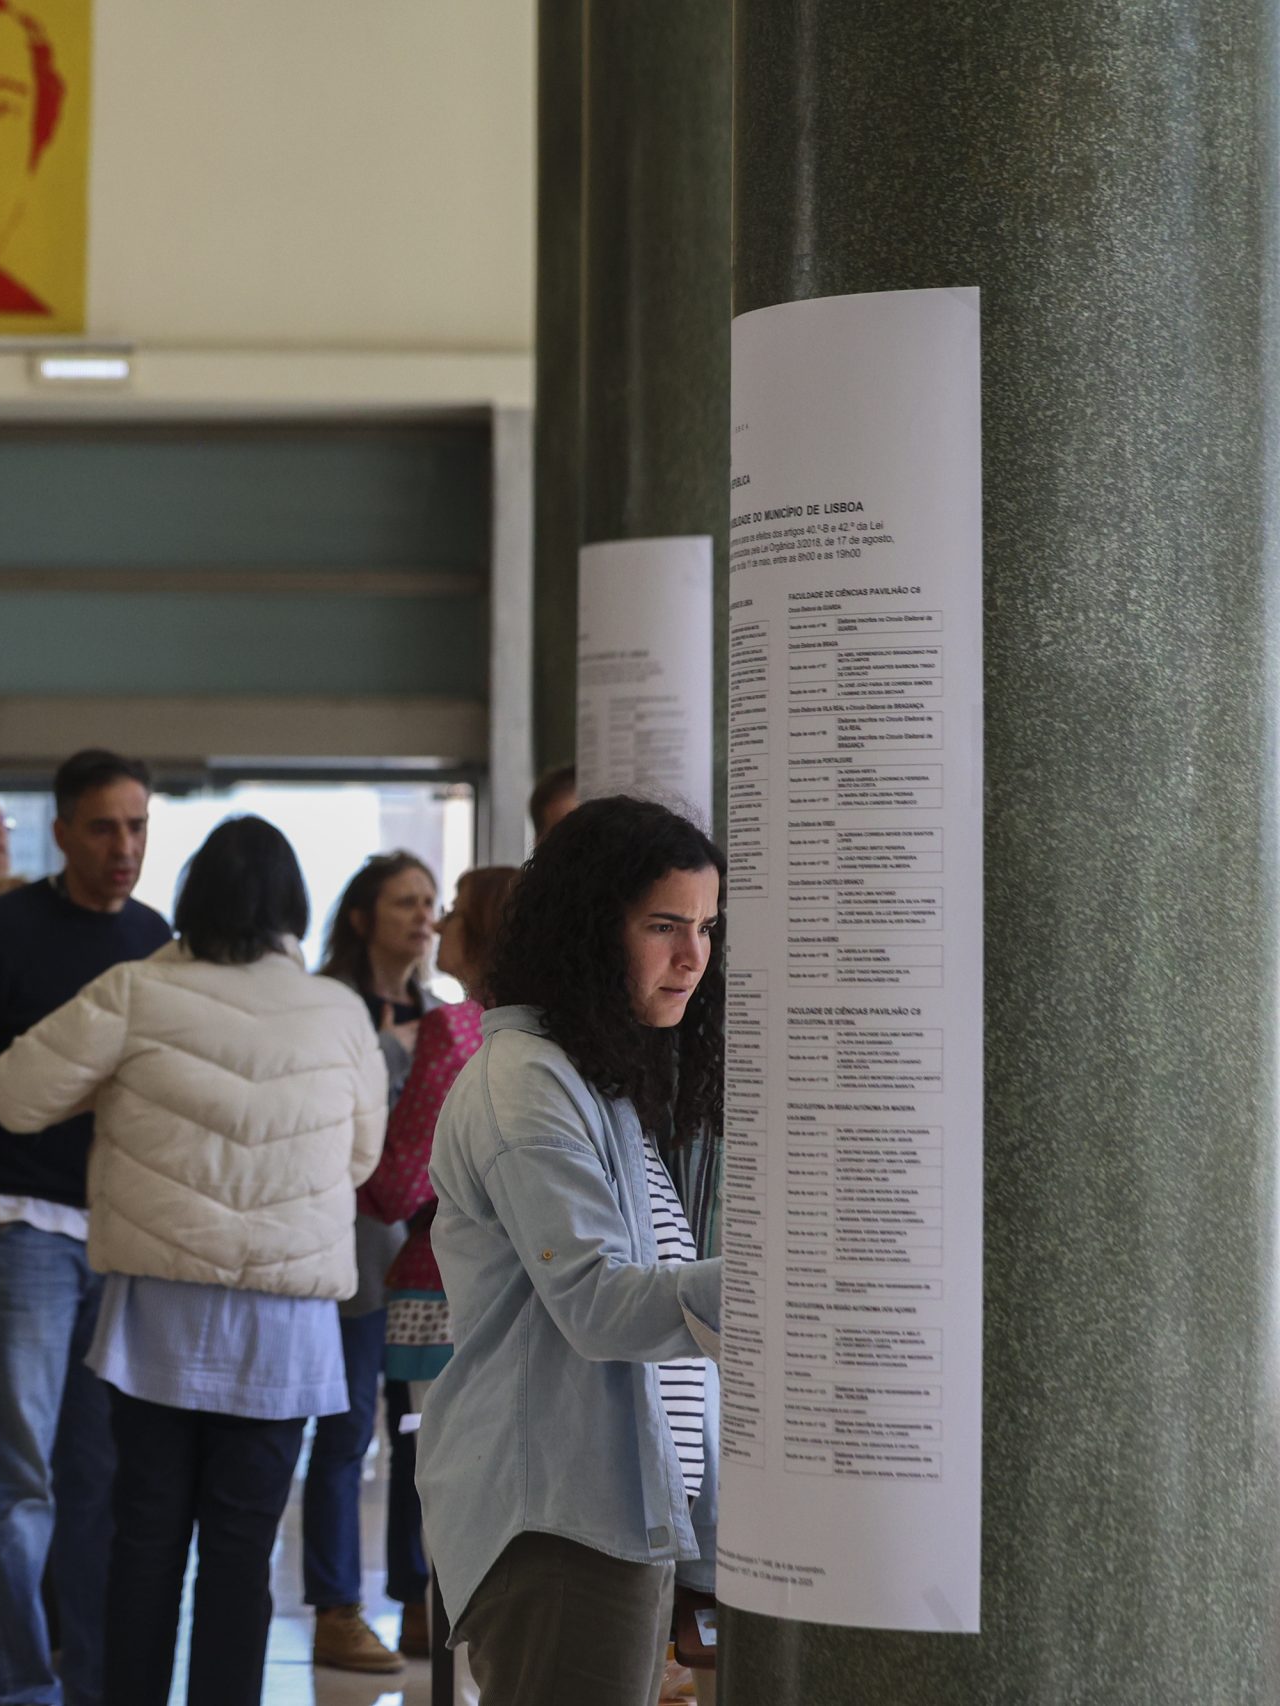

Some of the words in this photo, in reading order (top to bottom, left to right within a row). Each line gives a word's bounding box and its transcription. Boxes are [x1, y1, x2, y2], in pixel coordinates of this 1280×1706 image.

[764, 504, 804, 520] MUNICÍPIO
[806, 504, 820, 515] DE
[824, 501, 864, 514] LISBOA
[856, 521, 868, 531] da
[870, 520, 884, 530] Lei
[824, 536, 834, 546] de
[837, 536, 847, 545] 17
[848, 535, 860, 545] de
[862, 534, 896, 546] agosto,
[788, 590, 824, 600] FACULDADE
[824, 590, 834, 598] DE
[835, 588, 868, 597] CIÊNCIAS
[869, 586, 908, 596] PAVILHÃO
[824, 1007, 833, 1015] DE
[835, 1006, 868, 1016] CIÊNCIAS
[870, 1006, 909, 1016] PAVILHÃO
